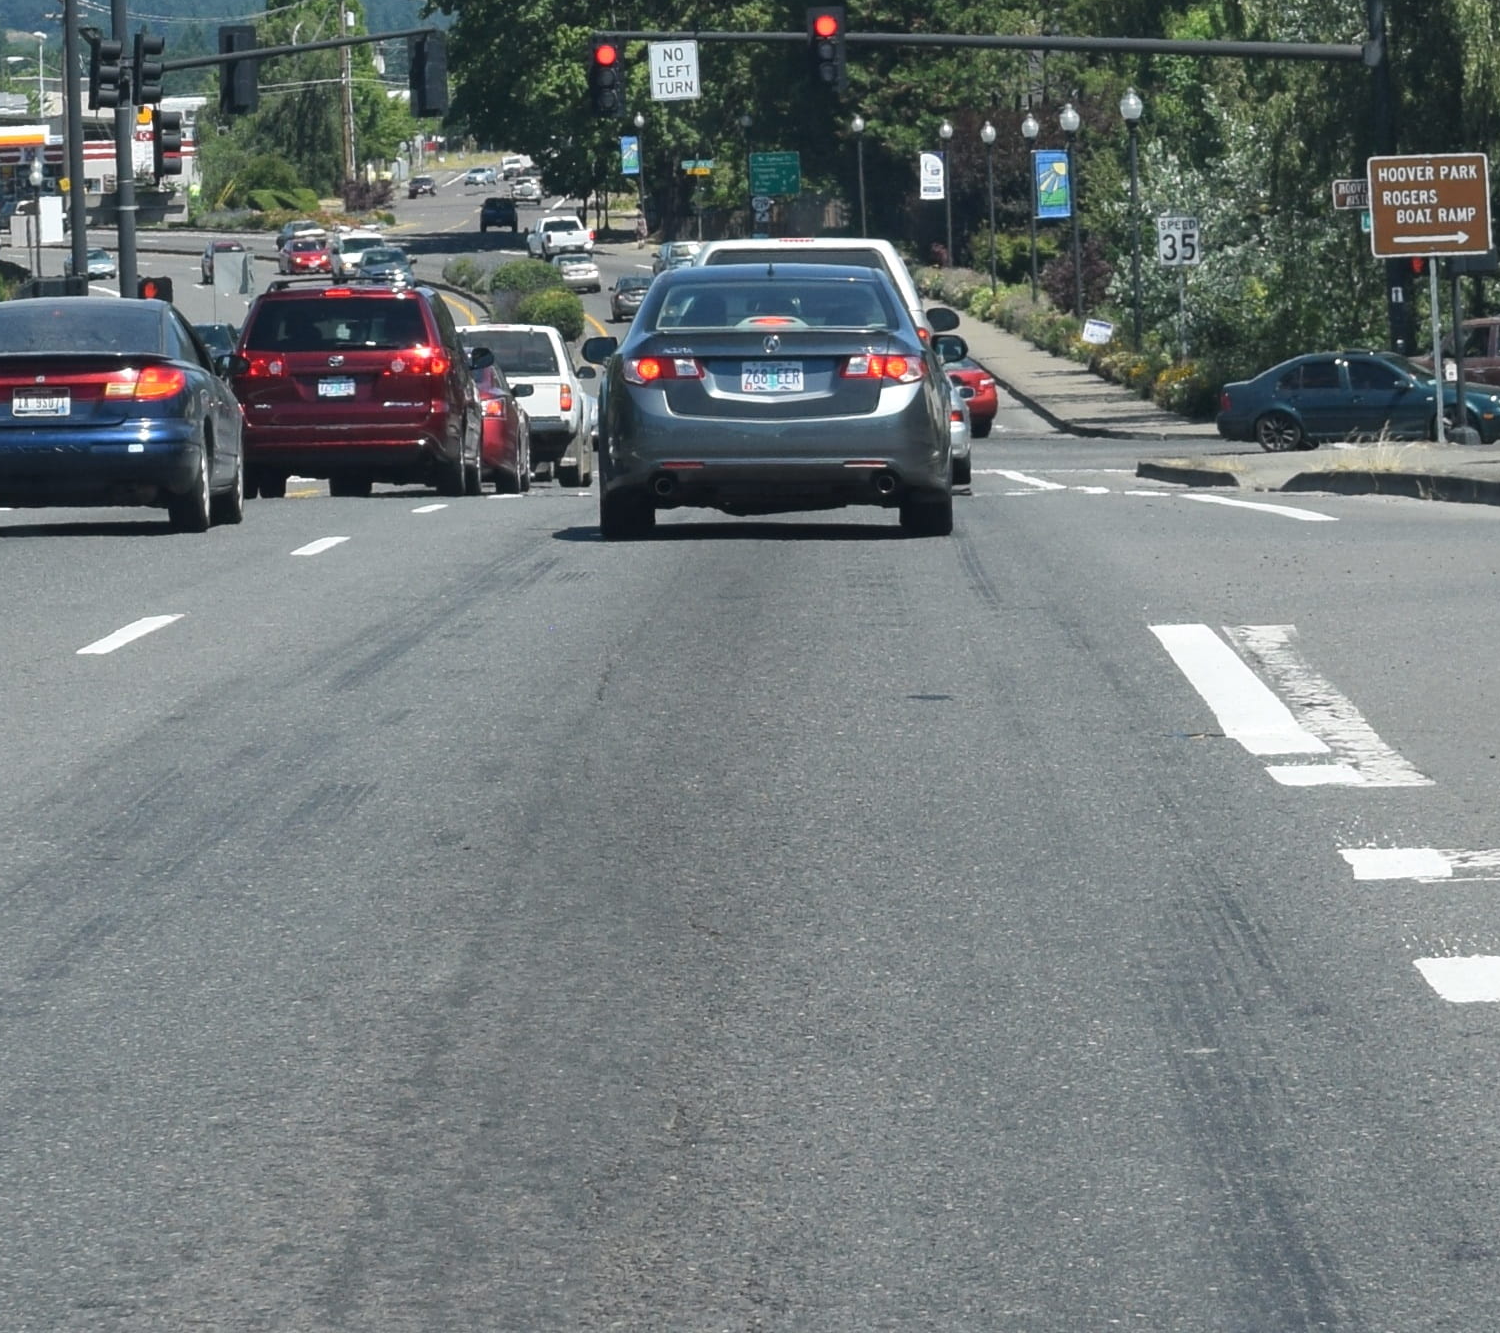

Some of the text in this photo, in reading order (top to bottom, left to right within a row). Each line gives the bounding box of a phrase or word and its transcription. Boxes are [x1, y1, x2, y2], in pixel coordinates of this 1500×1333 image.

[663, 47, 684, 62] NO
[658, 64, 691, 79] LEFT
[656, 80, 693, 95] TURN
[1378, 165, 1478, 182] HOOVER PARK
[1382, 189, 1438, 206] ROGERS
[1396, 207, 1476, 224] BOAT RAMP
[745, 367, 800, 384] 268 EER
